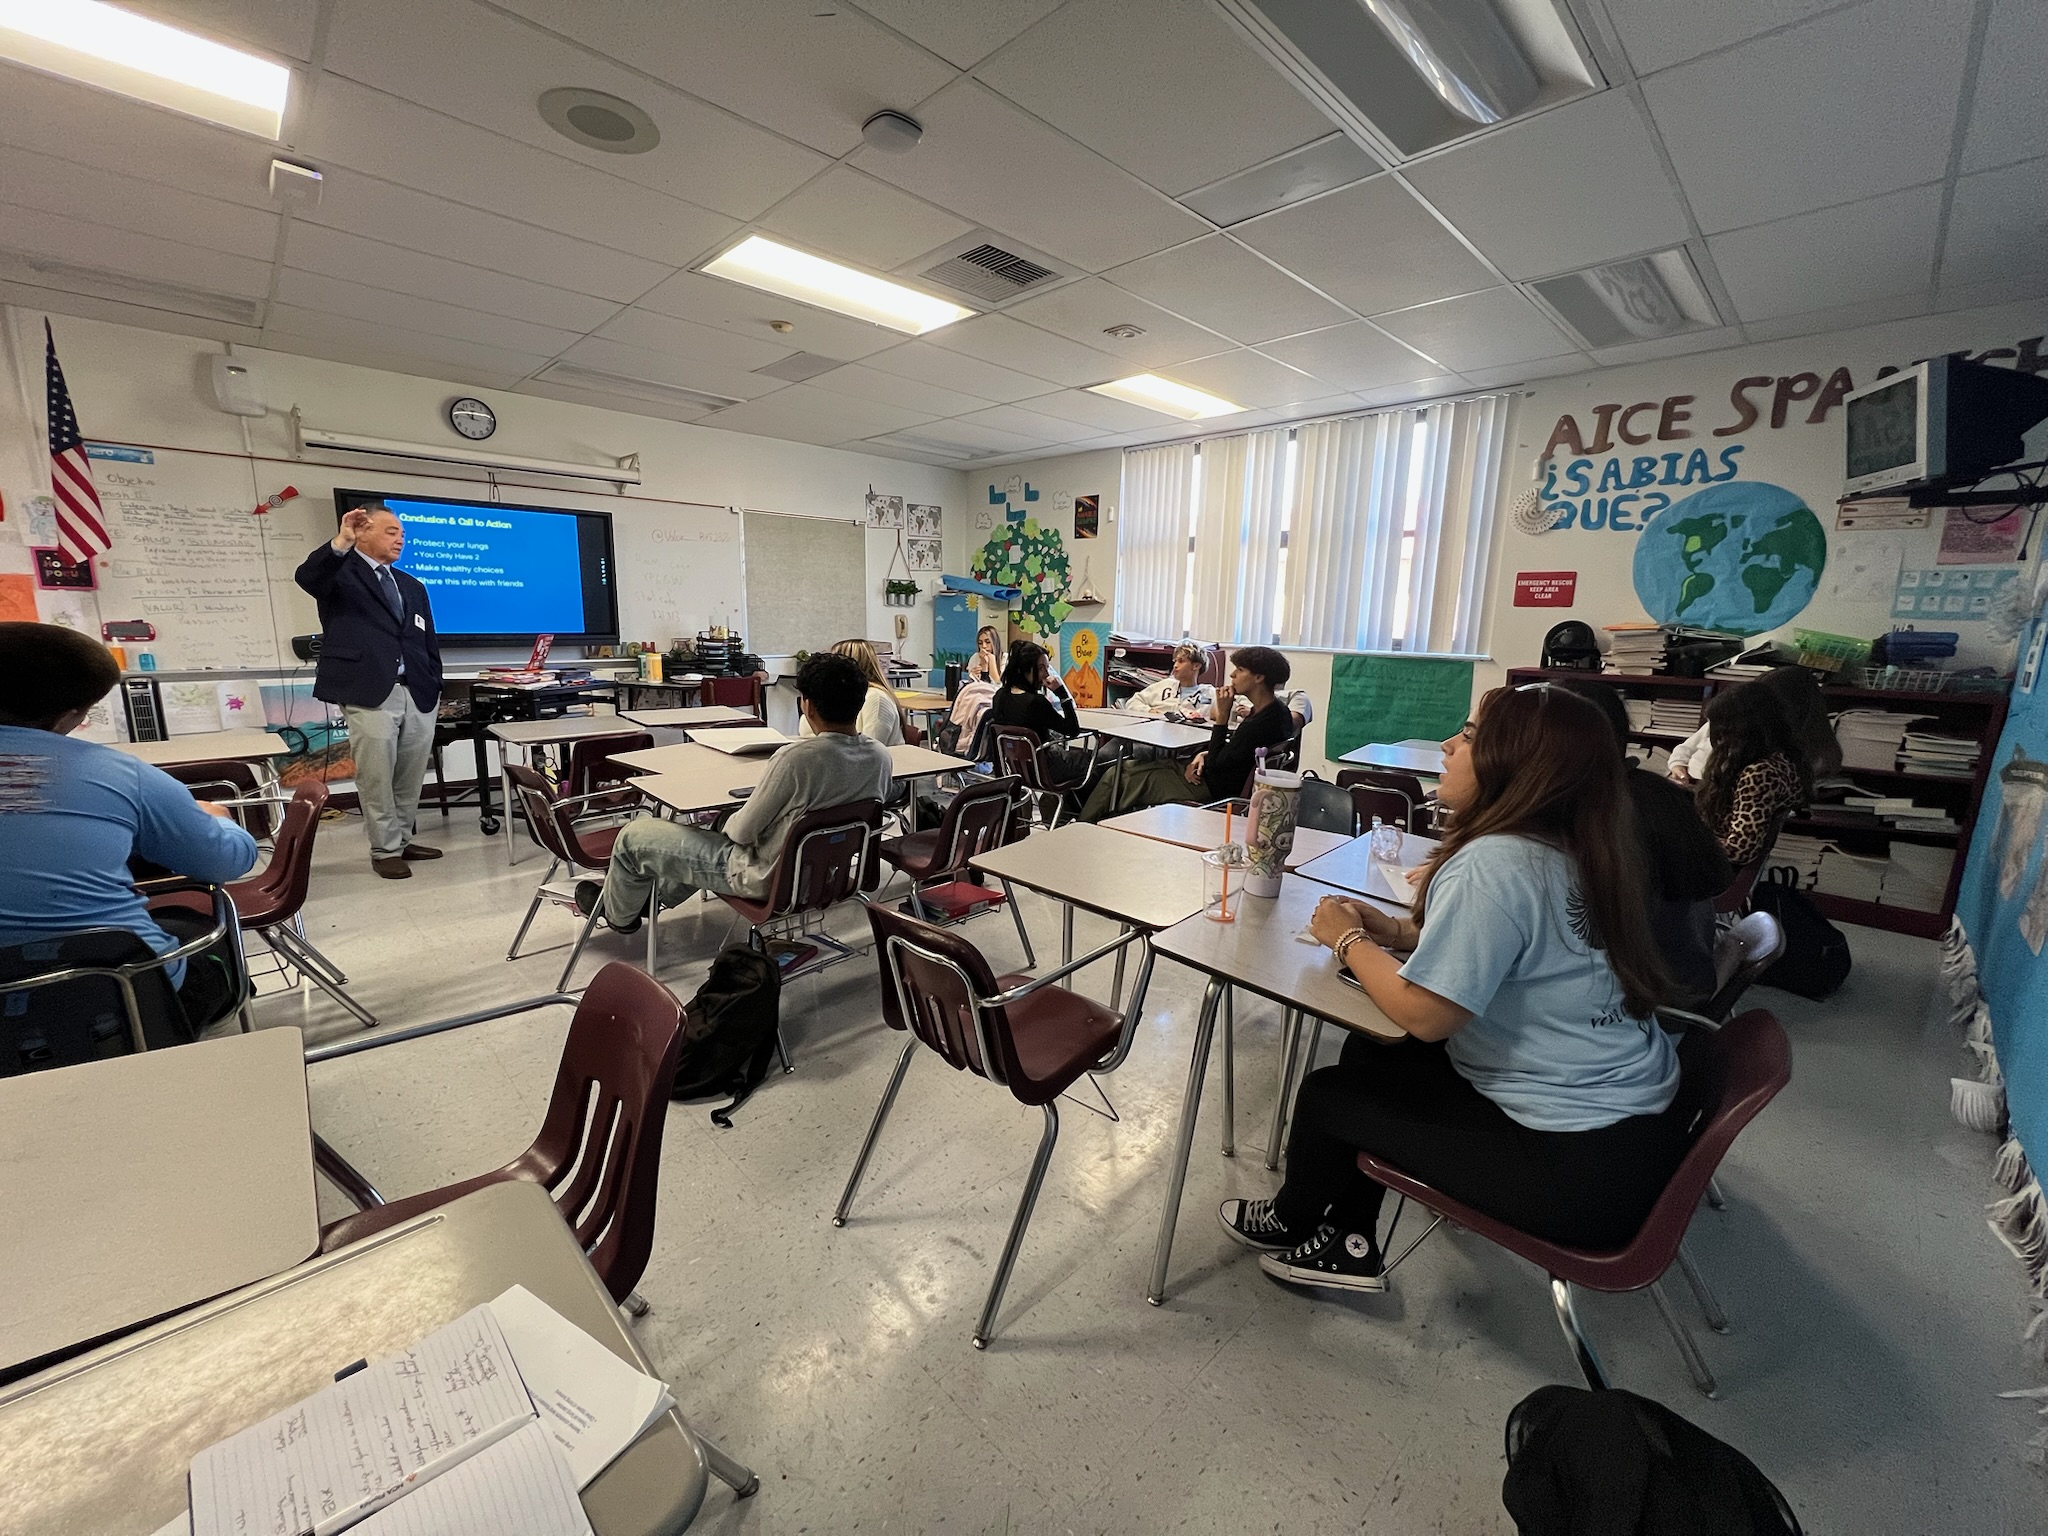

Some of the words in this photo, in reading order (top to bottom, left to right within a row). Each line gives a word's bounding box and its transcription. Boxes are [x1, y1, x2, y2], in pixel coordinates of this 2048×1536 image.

[1541, 394, 1697, 461] AICE
[399, 513, 448, 525] Conclusion
[448, 517, 456, 525] &
[458, 518, 474, 527] Call
[475, 519, 485, 527] to
[485, 520, 512, 529] Action
[413, 538, 445, 548] Protect
[447, 542, 465, 550] your
[467, 541, 489, 550] lungs
[419, 551, 435, 559] You
[436, 552, 453, 561] Only
[416, 563, 440, 572] Make
[441, 565, 471, 574] healthy
[473, 566, 504, 574] choices
[445, 578, 460, 586] this
[462, 578, 477, 586] info
[479, 579, 496, 587] with
[497, 579, 524, 587] friends
[1081, 634, 1088, 646] Be
